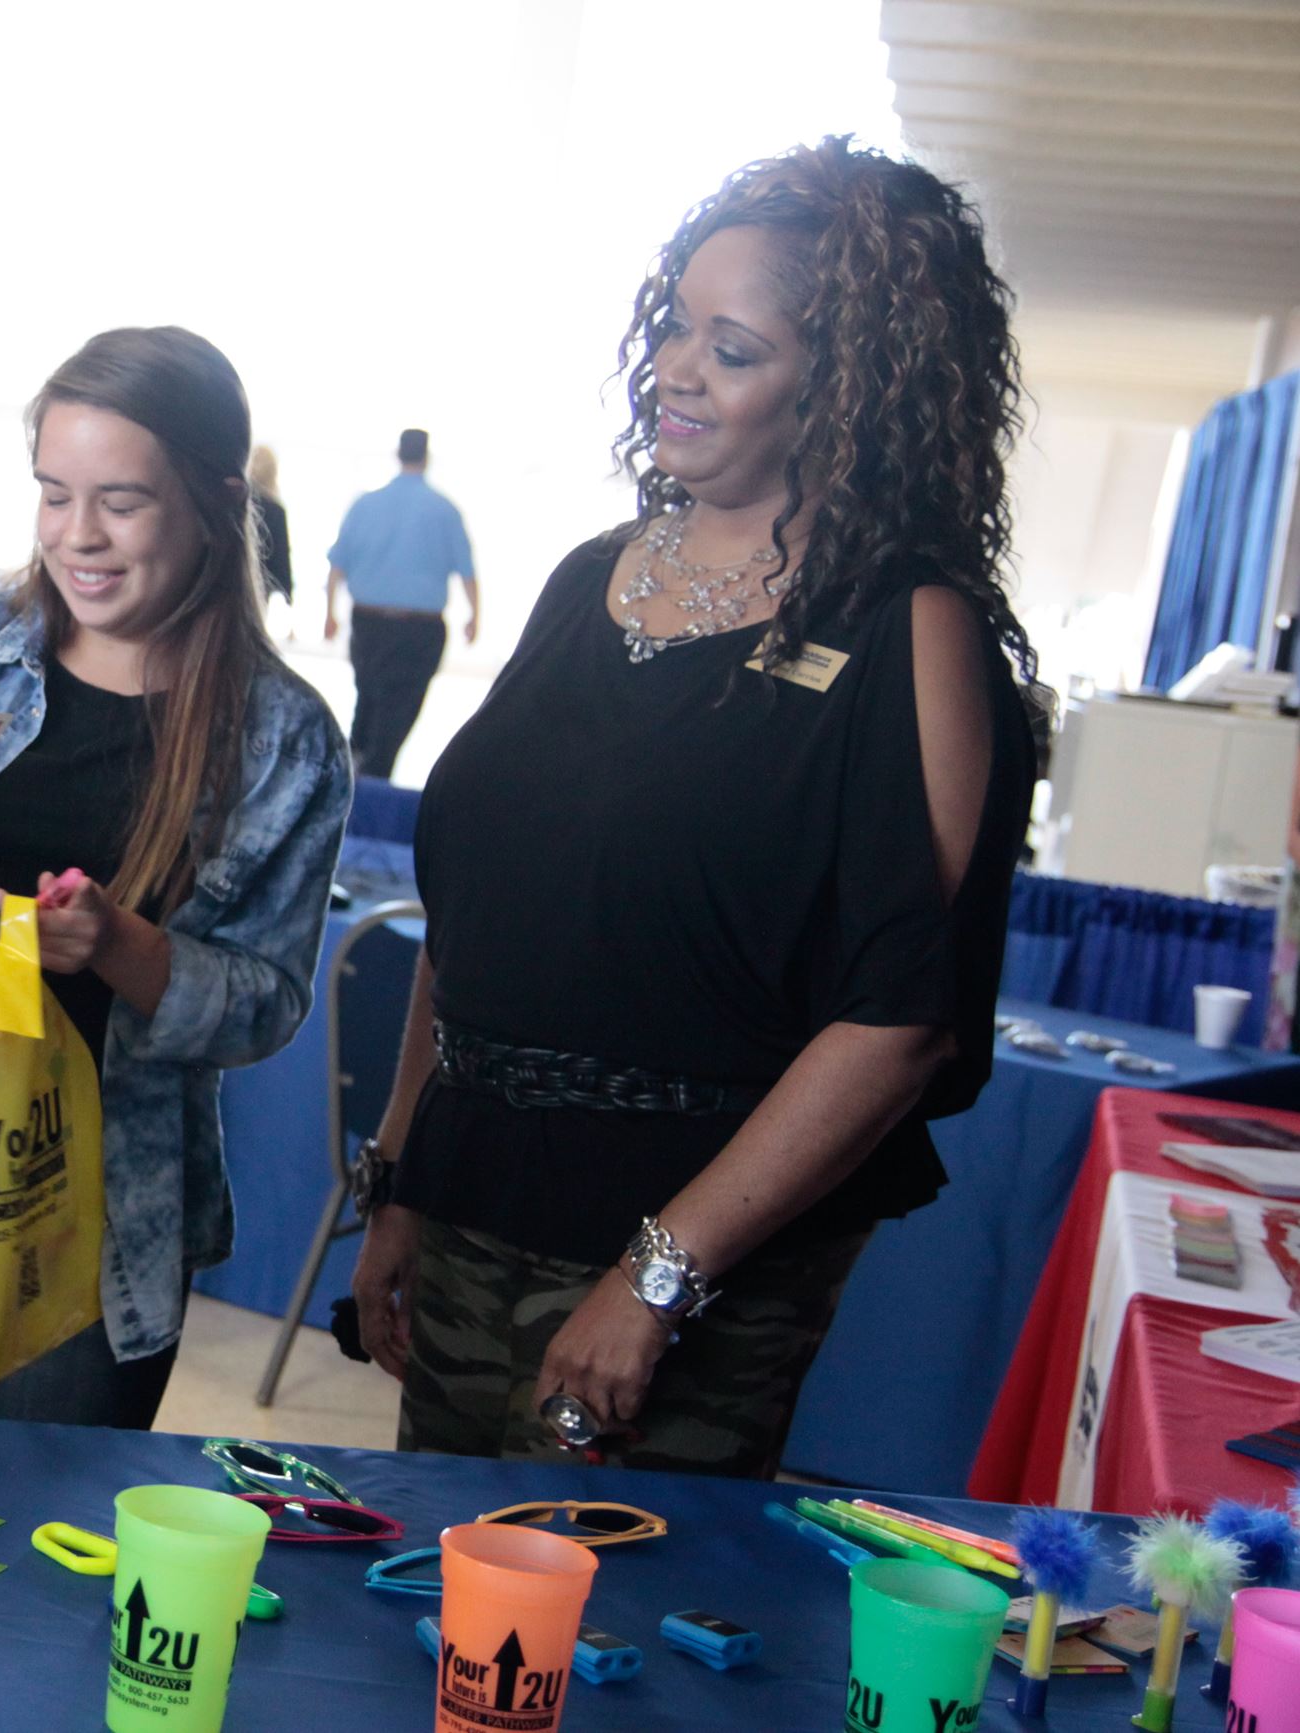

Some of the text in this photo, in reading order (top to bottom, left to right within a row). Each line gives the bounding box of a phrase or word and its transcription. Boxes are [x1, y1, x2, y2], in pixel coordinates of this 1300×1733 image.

[147, 1626, 199, 1670] 2U
[120, 1664, 188, 1690] PATHWAYS
[441, 1635, 563, 1709] Your 2U
[128, 1684, 190, 1706] 800-457-5633
[478, 1684, 488, 1703] is
[849, 1678, 884, 1729] 2U
